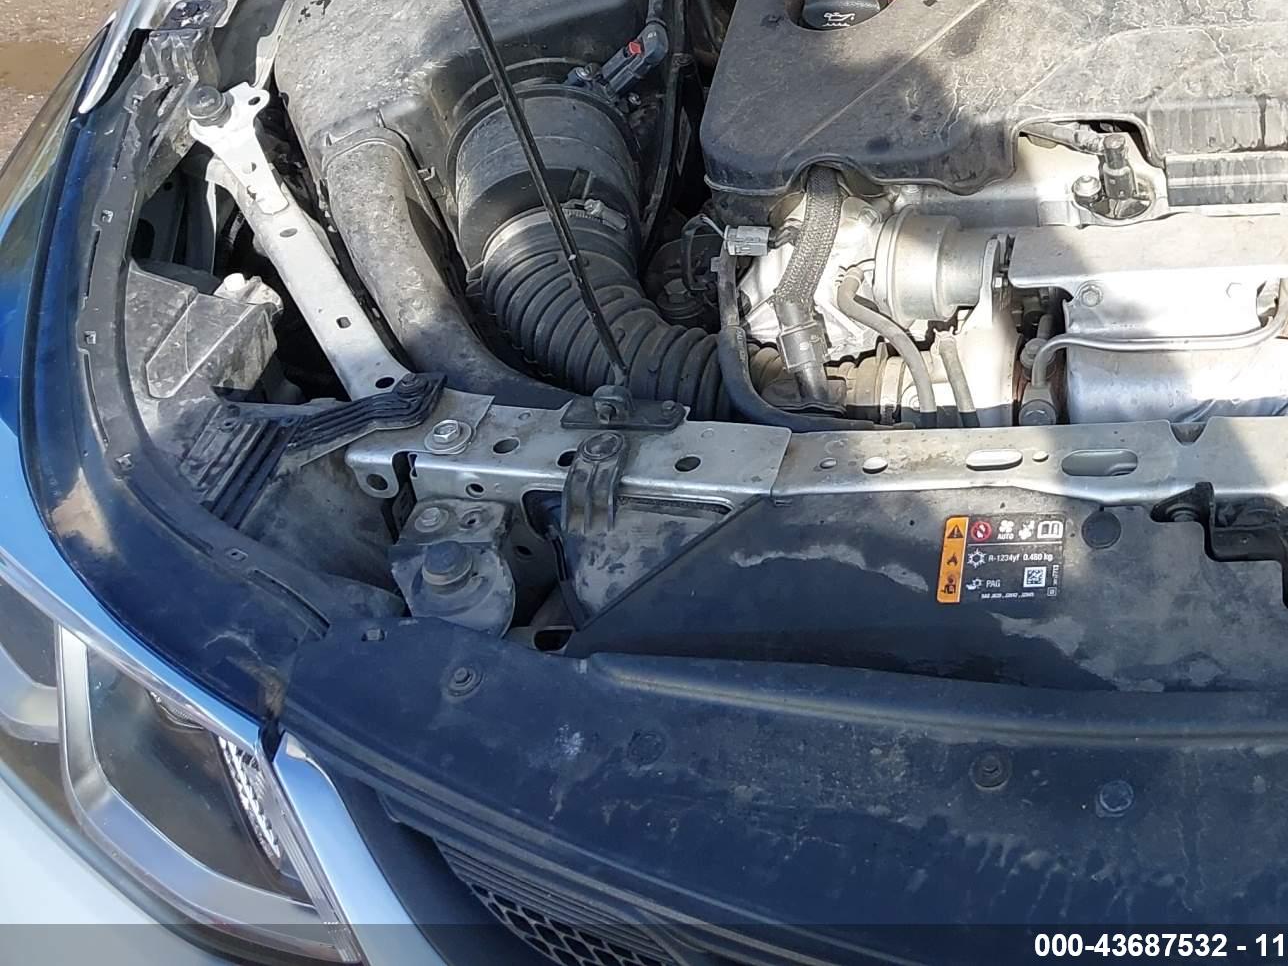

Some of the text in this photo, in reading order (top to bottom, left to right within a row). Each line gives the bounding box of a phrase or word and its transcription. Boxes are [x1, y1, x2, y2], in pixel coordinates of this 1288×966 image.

[997, 532, 1014, 540] AUTO
[988, 553, 1020, 563] R-1234yf
[1043, 552, 1054, 563] kg
[986, 579, 1001, 588] PAG
